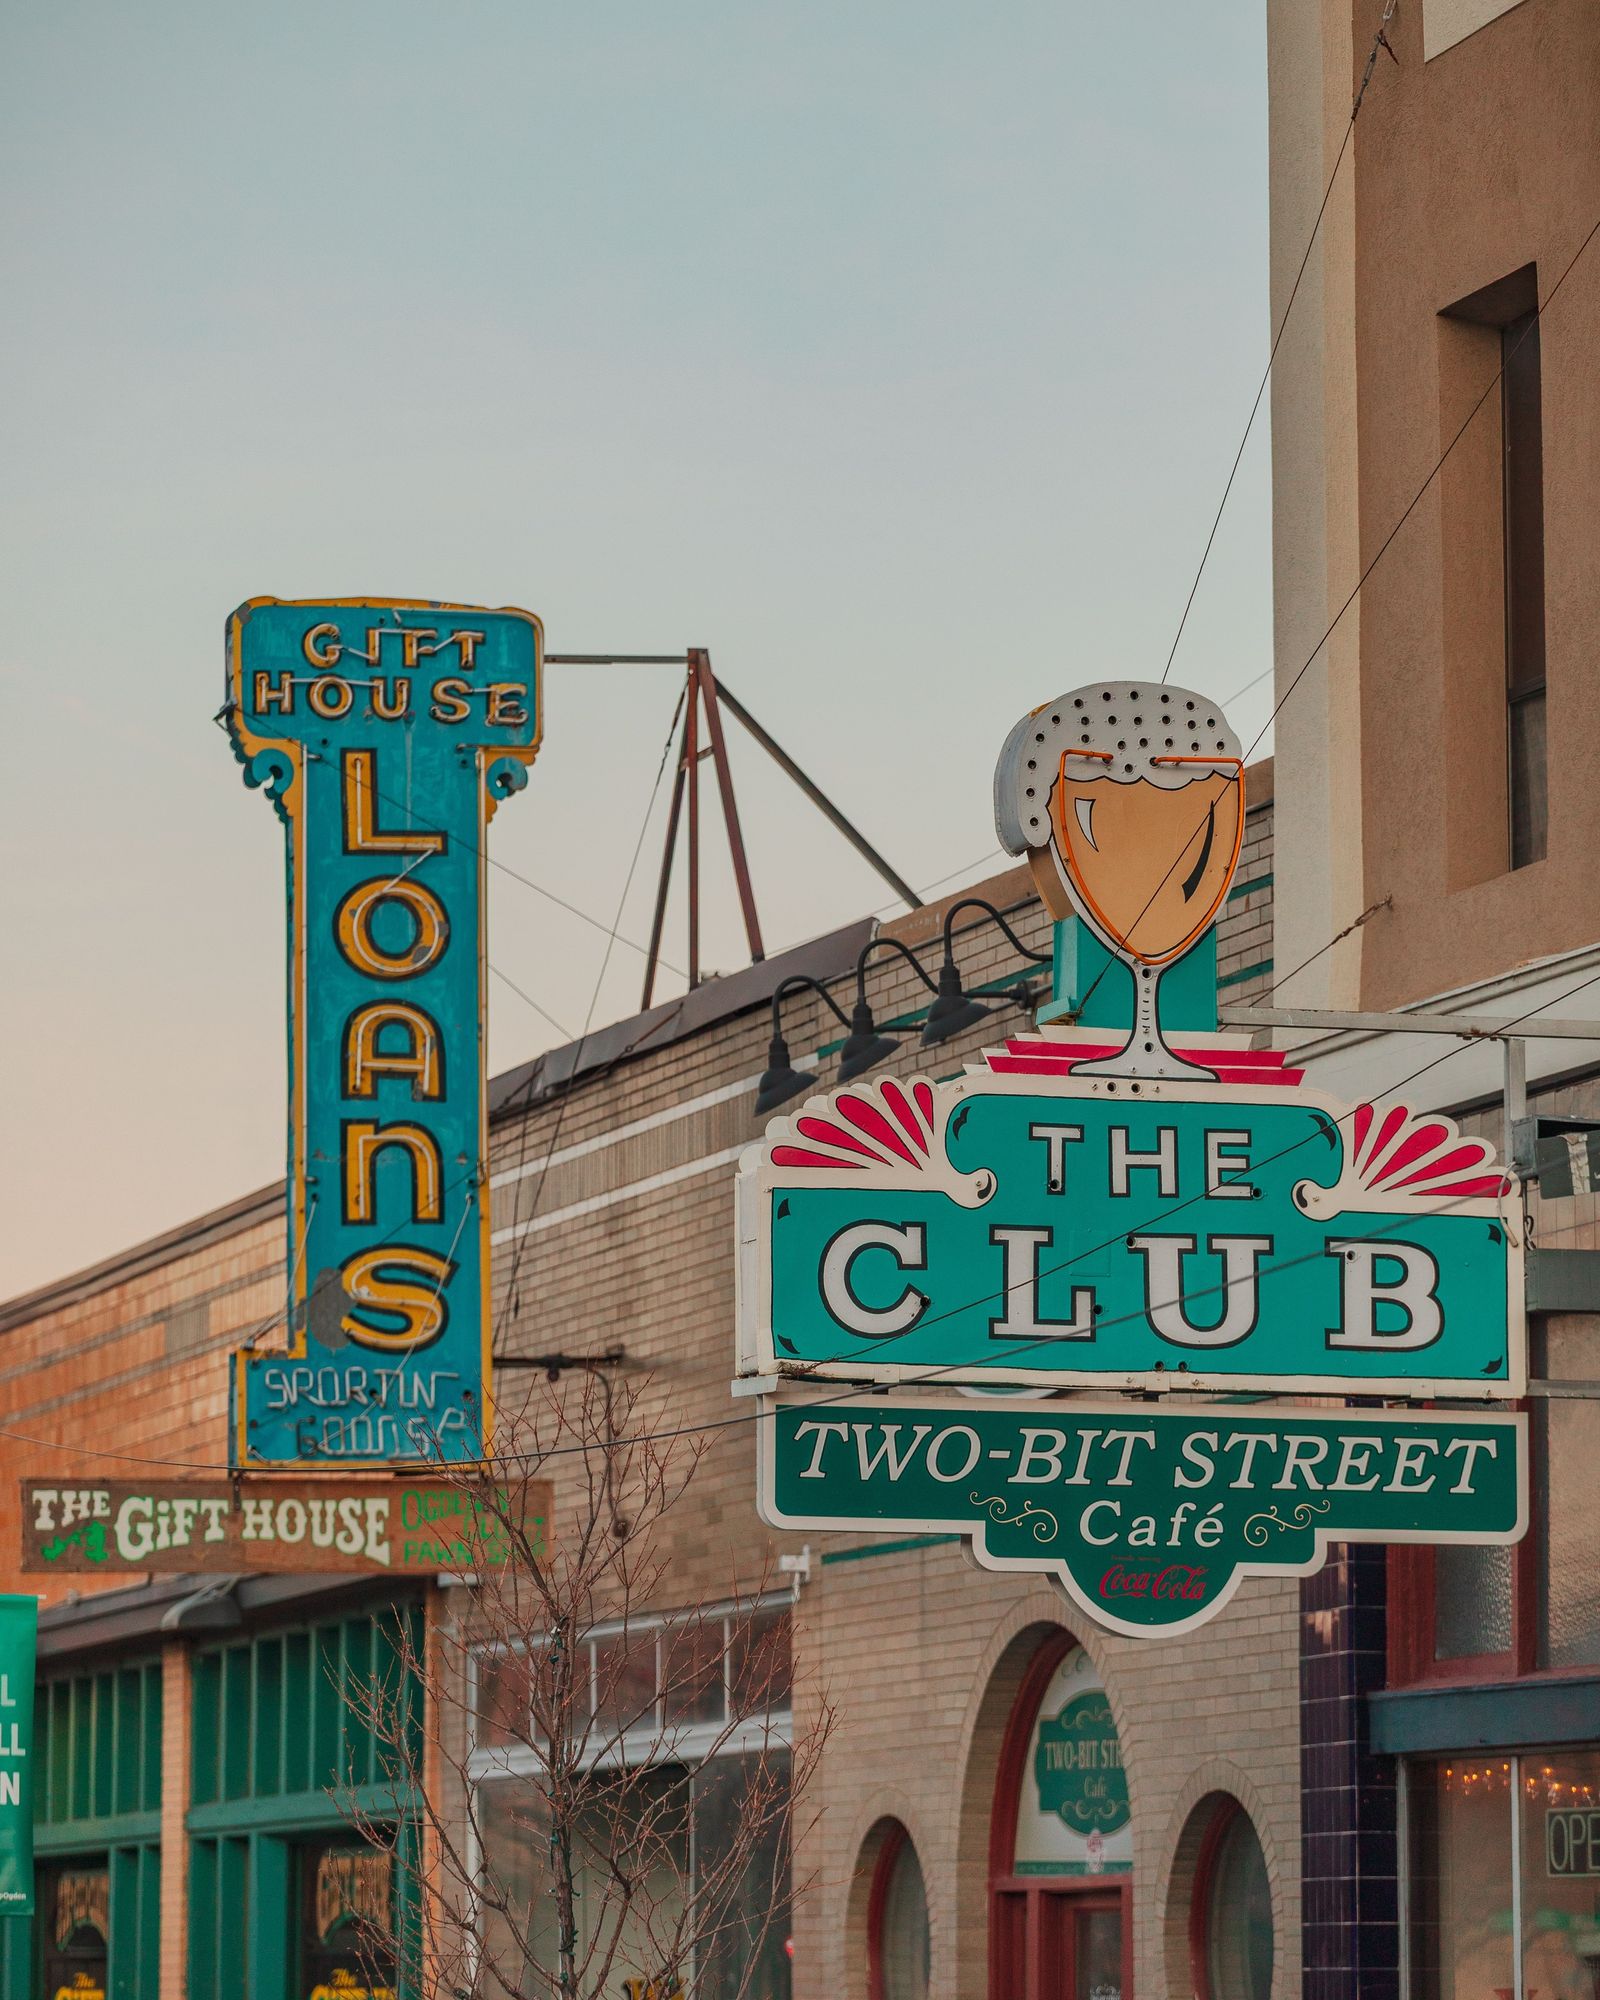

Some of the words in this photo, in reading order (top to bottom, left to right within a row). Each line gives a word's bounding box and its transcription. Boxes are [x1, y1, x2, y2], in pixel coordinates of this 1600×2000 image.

[302, 623, 486, 671] GIFT
[253, 670, 530, 727] HOUSE
[1028, 1122, 1255, 1200] THE
[818, 1218, 1446, 1352] CLUB
[794, 1420, 1157, 1487] TWO-BIT
[1173, 1430, 1498, 1495] STREET
[32, 1489, 111, 1531] THE
[241, 1497, 391, 1567] HOUSE
[1078, 1499, 1225, 1548] Café
[1098, 1563, 1209, 1599] Coca-Cola
[1044, 1739, 1098, 1771] TWO-BIT
